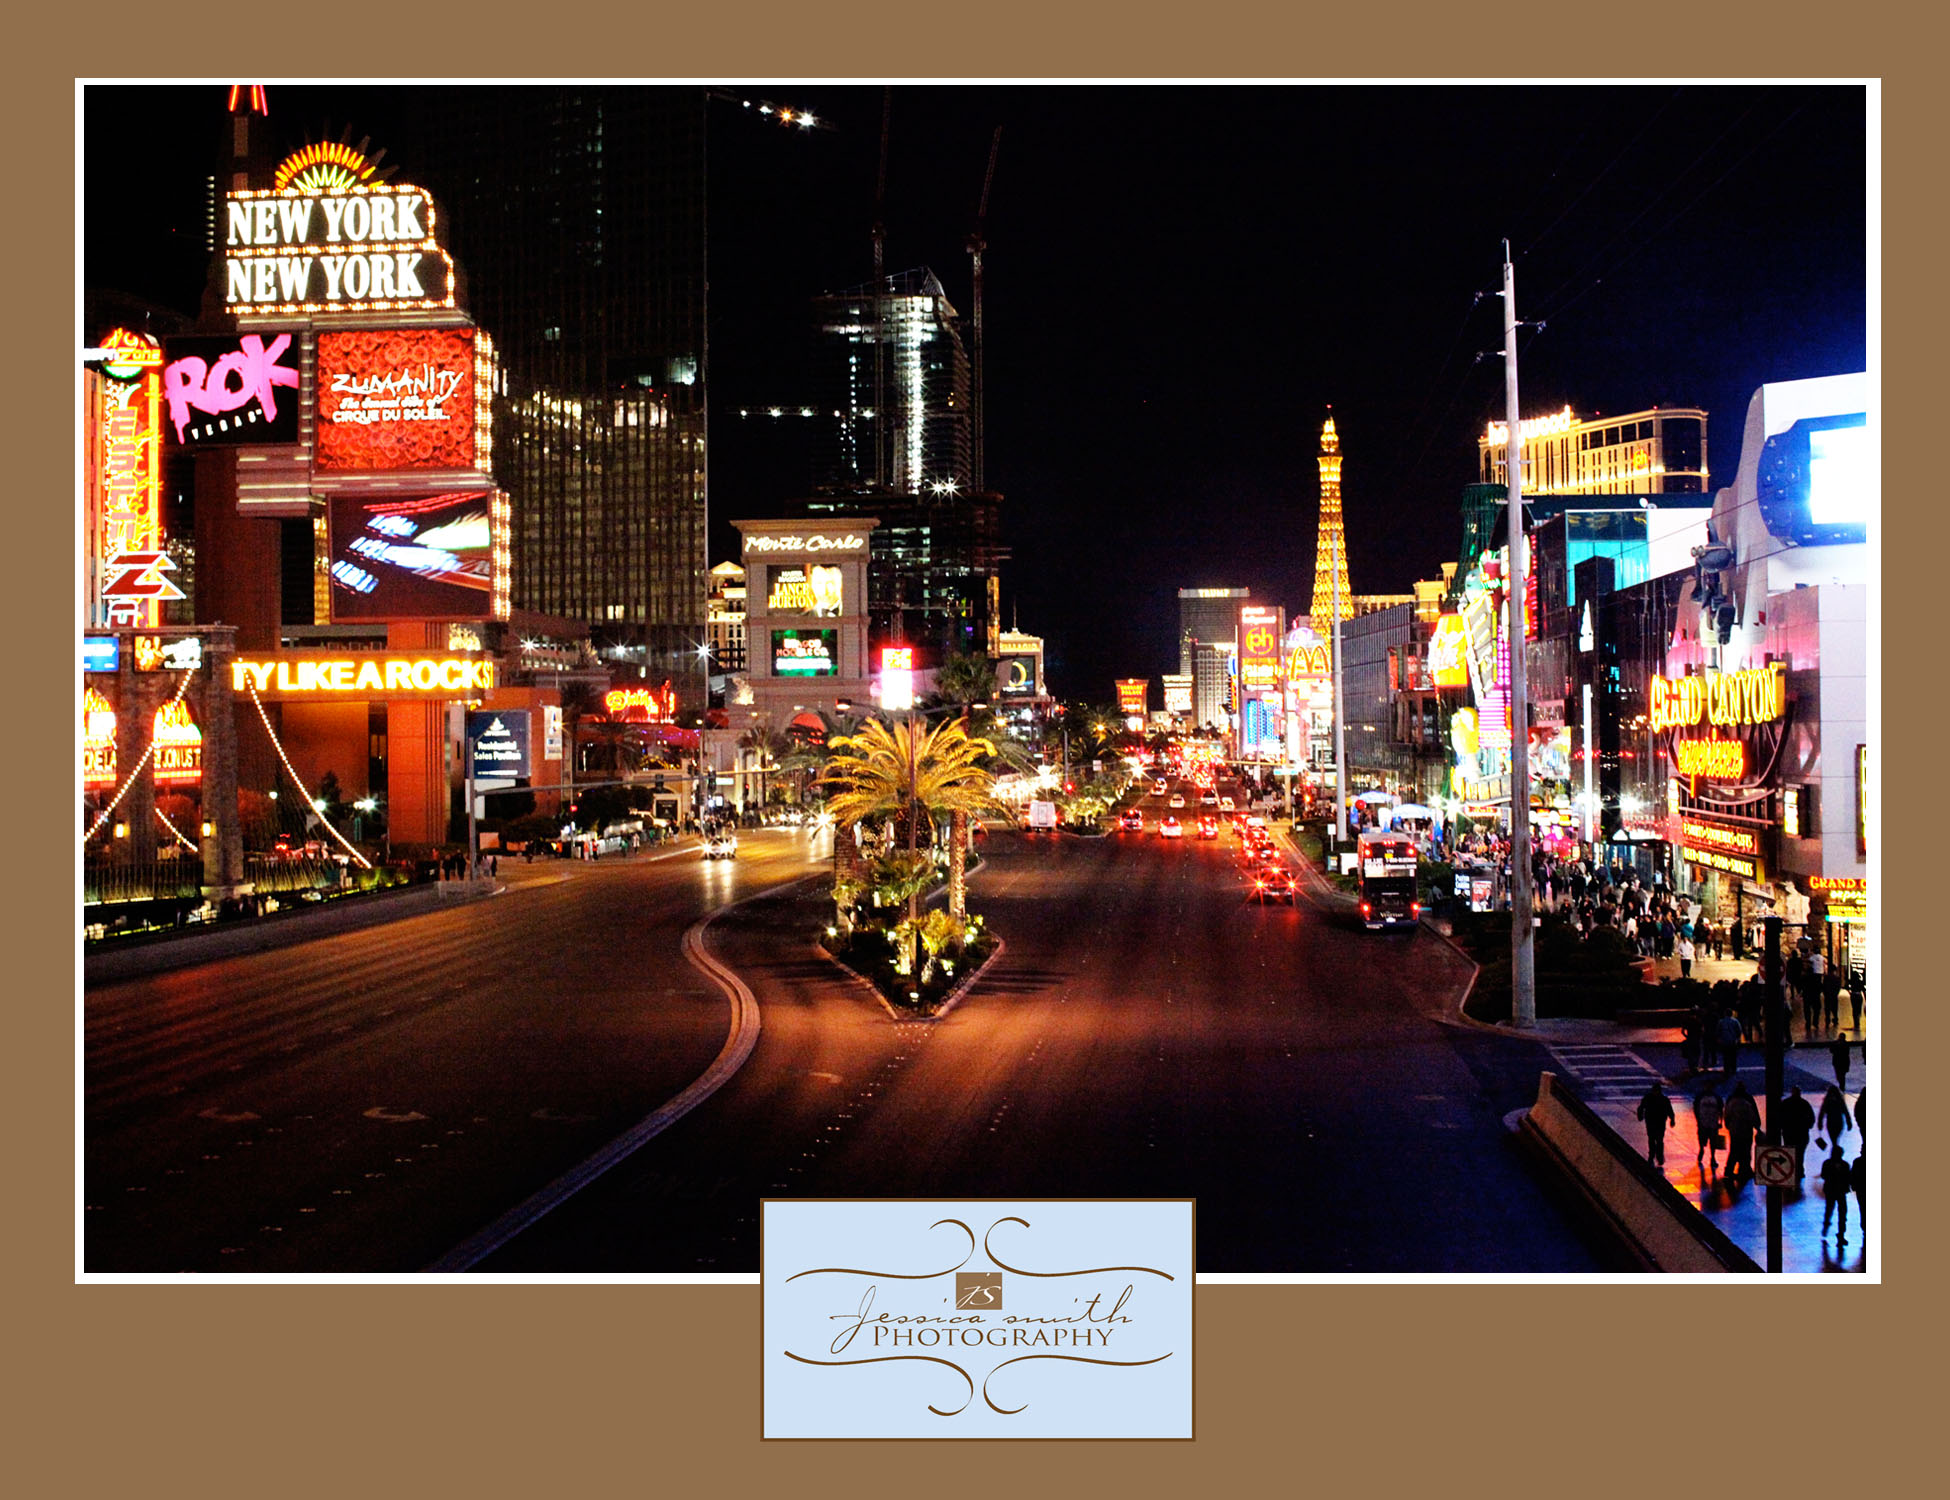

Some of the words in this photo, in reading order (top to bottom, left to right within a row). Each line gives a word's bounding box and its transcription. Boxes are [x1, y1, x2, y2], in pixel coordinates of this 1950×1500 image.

[227, 199, 313, 246] NEW
[321, 195, 424, 242] YORK
[226, 257, 313, 303] NEW
[322, 253, 424, 299] YORK
[164, 334, 299, 445] ROK
[331, 363, 464, 402] ZUMANITY
[332, 410, 379, 425] CIRQUE
[382, 409, 400, 421] DU
[745, 535, 805, 552] Monte
[805, 534, 863, 552] Carlo
[774, 583, 809, 596] LANCE
[1198, 588, 1230, 597] TRUMP
[768, 595, 815, 609] BURTON
[1649, 674, 1703, 734] GRAND
[1707, 662, 1780, 727] CANYON
[474, 751, 493, 760] Sales
[1809, 876, 1857, 889] GRAND
